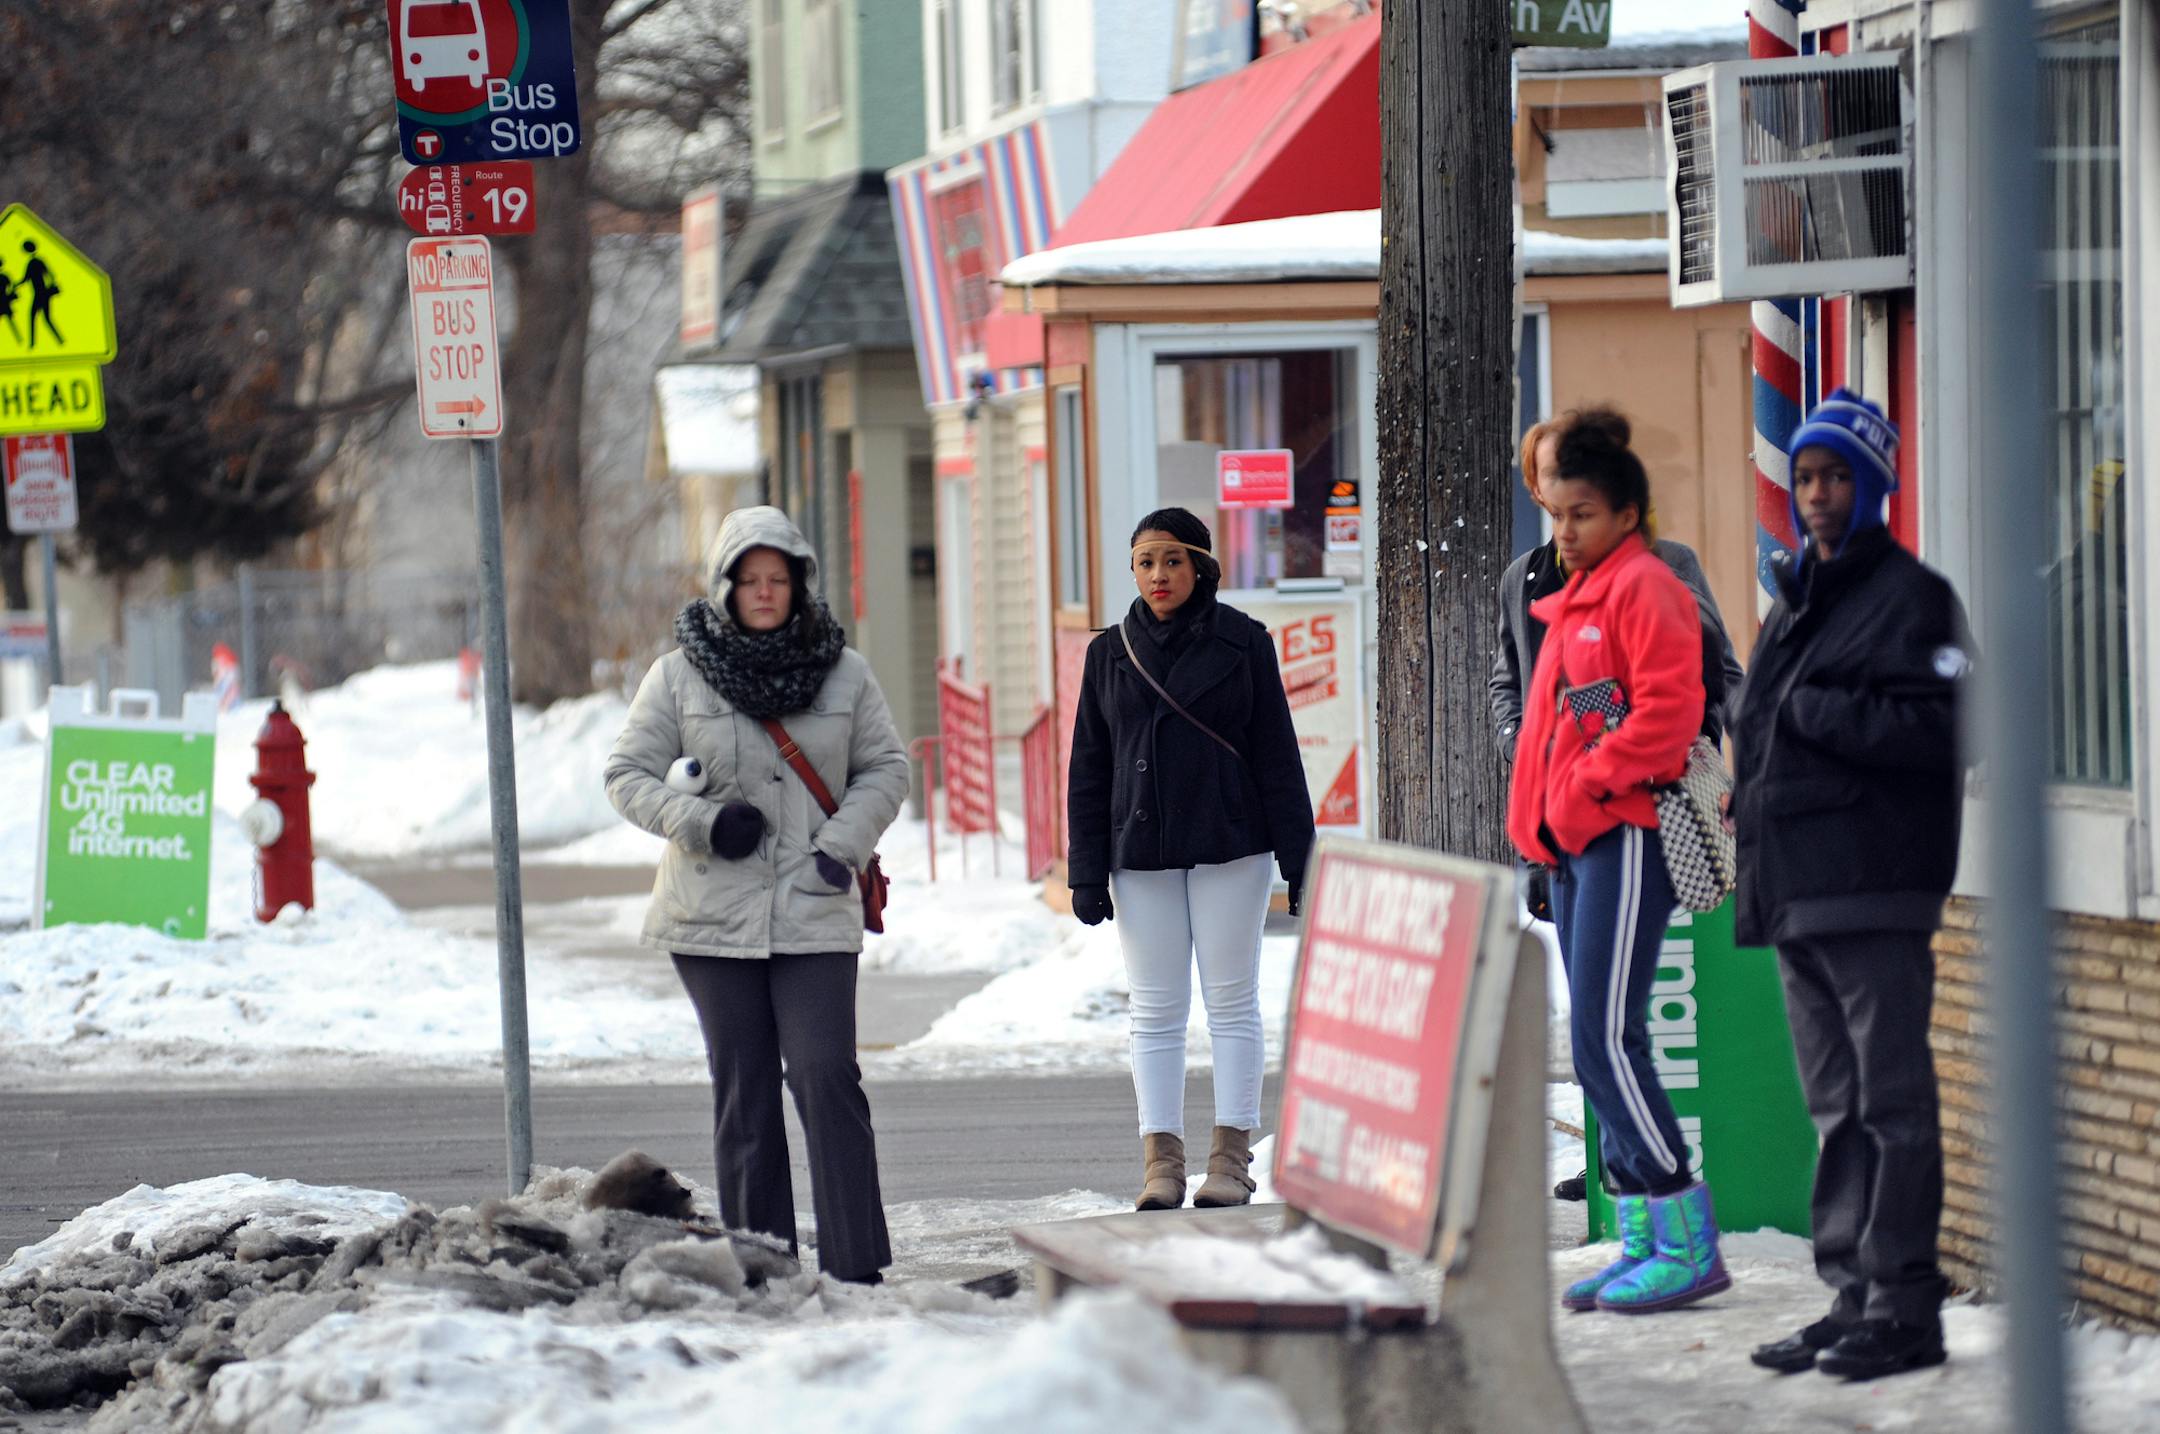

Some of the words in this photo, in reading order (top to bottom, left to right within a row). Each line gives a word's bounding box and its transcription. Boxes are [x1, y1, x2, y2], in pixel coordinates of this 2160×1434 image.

[1556, 0, 1609, 34] Av
[486, 78, 556, 112] Bus
[417, 135, 438, 155] T
[490, 117, 574, 157] Stop
[475, 171, 503, 180] Route
[400, 187, 425, 211] hi
[450, 165, 463, 233] FREQUENCY
[482, 187, 528, 224] 19
[412, 254, 437, 286] NO
[439, 254, 486, 281] PARKING
[431, 299, 476, 336] BUS
[429, 343, 485, 381] STOP
[1269, 613, 1336, 663] ES
[67, 758, 175, 790] CLEAR
[61, 783, 206, 817] Unlimited
[78, 810, 125, 834] 4G
